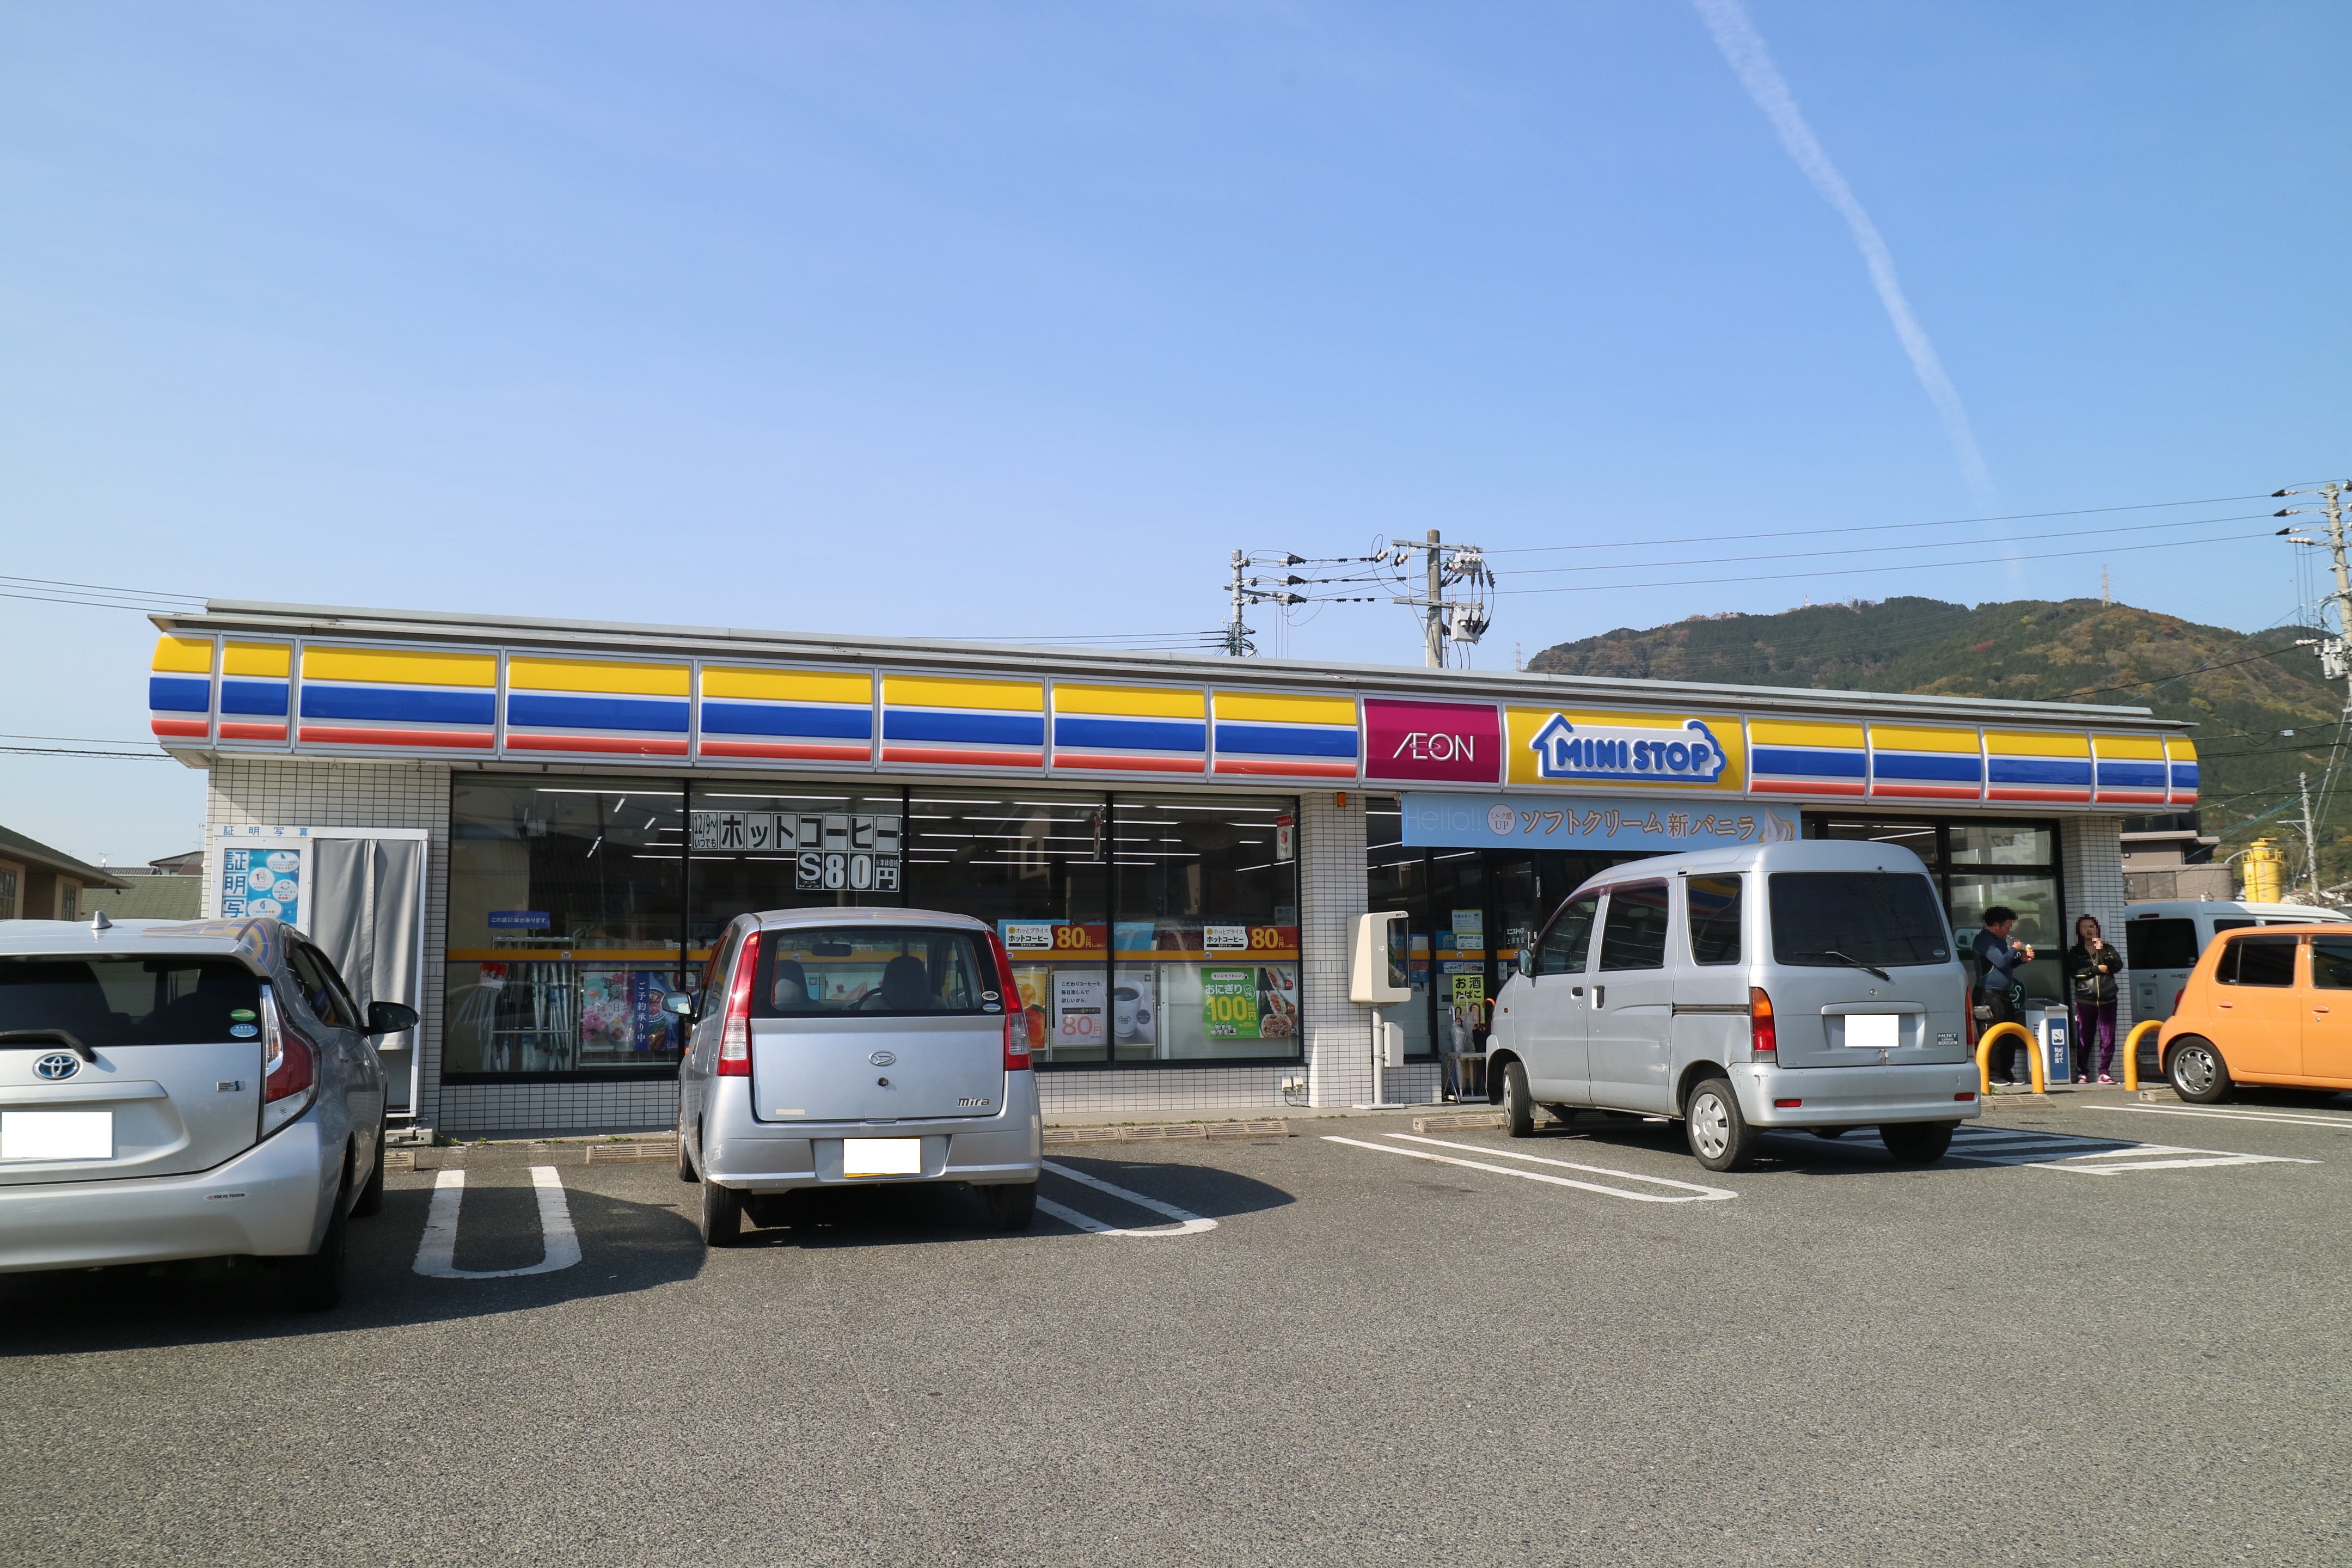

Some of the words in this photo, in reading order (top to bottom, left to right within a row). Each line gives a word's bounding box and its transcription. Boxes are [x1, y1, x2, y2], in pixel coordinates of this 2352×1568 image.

[1555, 736, 1627, 768] MINI
[1632, 739, 1710, 772] STOP
[1405, 805, 1481, 831] Hello!!
[1490, 811, 1512, 820] ミルク感
[1495, 820, 1509, 830] UP
[721, 814, 898, 848] ホットコーヒー
[694, 838, 716, 848] いつでも
[1506, 927, 1524, 935] ミニストップ
[1008, 934, 1049, 942] ホットコーヒー
[1455, 977, 1481, 989] お酒
[1205, 983, 1242, 995] おにぎり
[1455, 990, 1481, 999] たばこ
[597, 1003, 620, 1013] 母の日
[637, 981, 647, 1043] ご予約承り中
